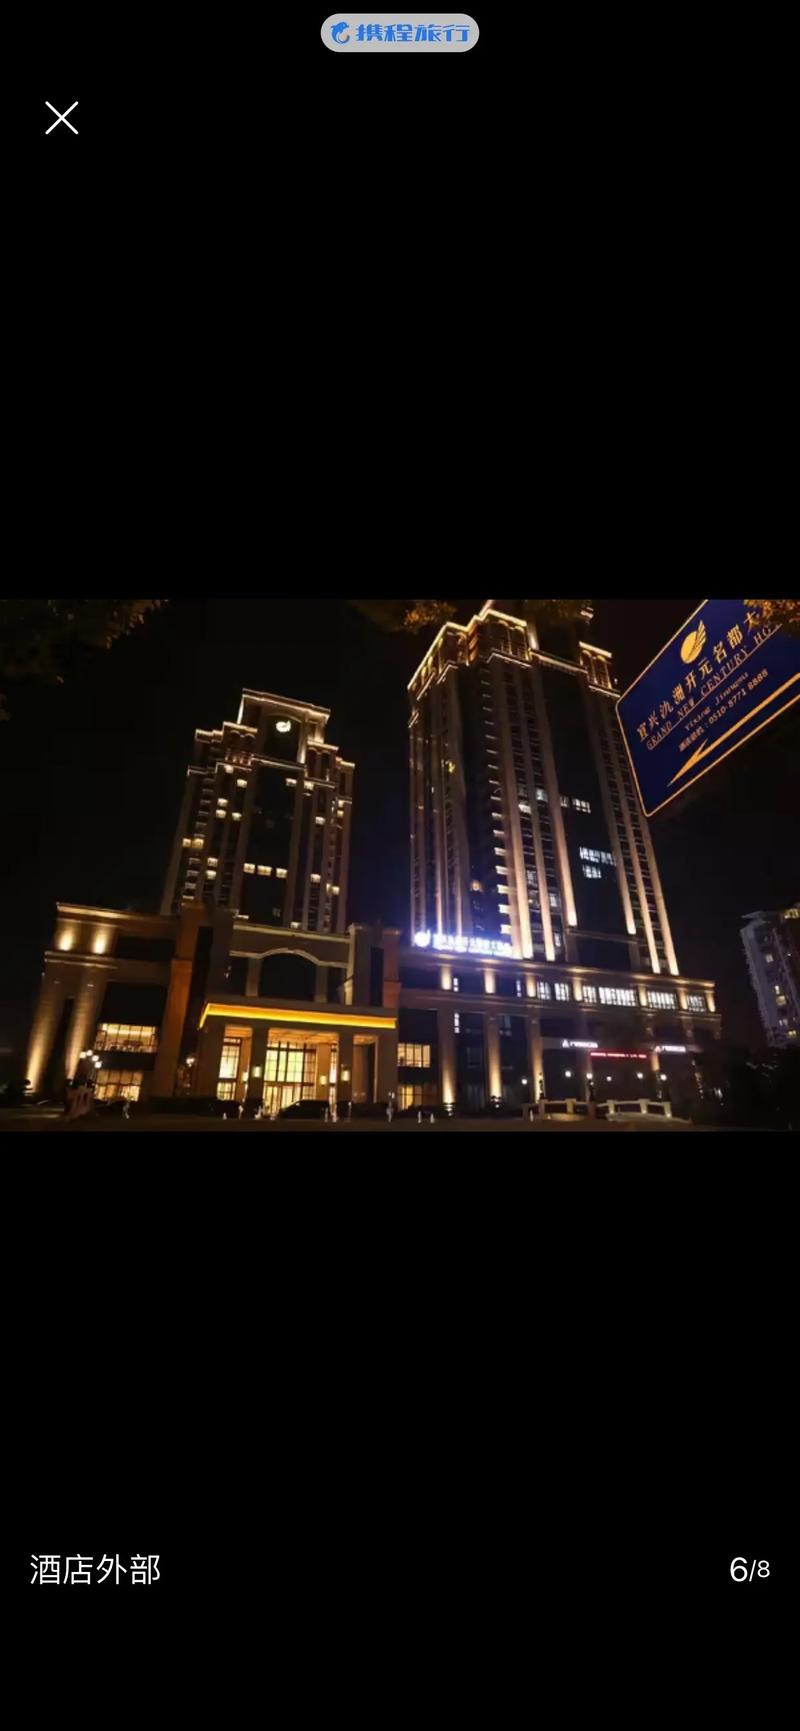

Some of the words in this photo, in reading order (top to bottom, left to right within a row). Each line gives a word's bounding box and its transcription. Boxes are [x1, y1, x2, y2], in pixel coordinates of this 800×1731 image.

[637, 611, 760, 742] 宜兴氿洲开元名都大
[646, 720, 673, 750] GRAND
[677, 698, 696, 719] NEW
[700, 646, 748, 697] CENTURY
